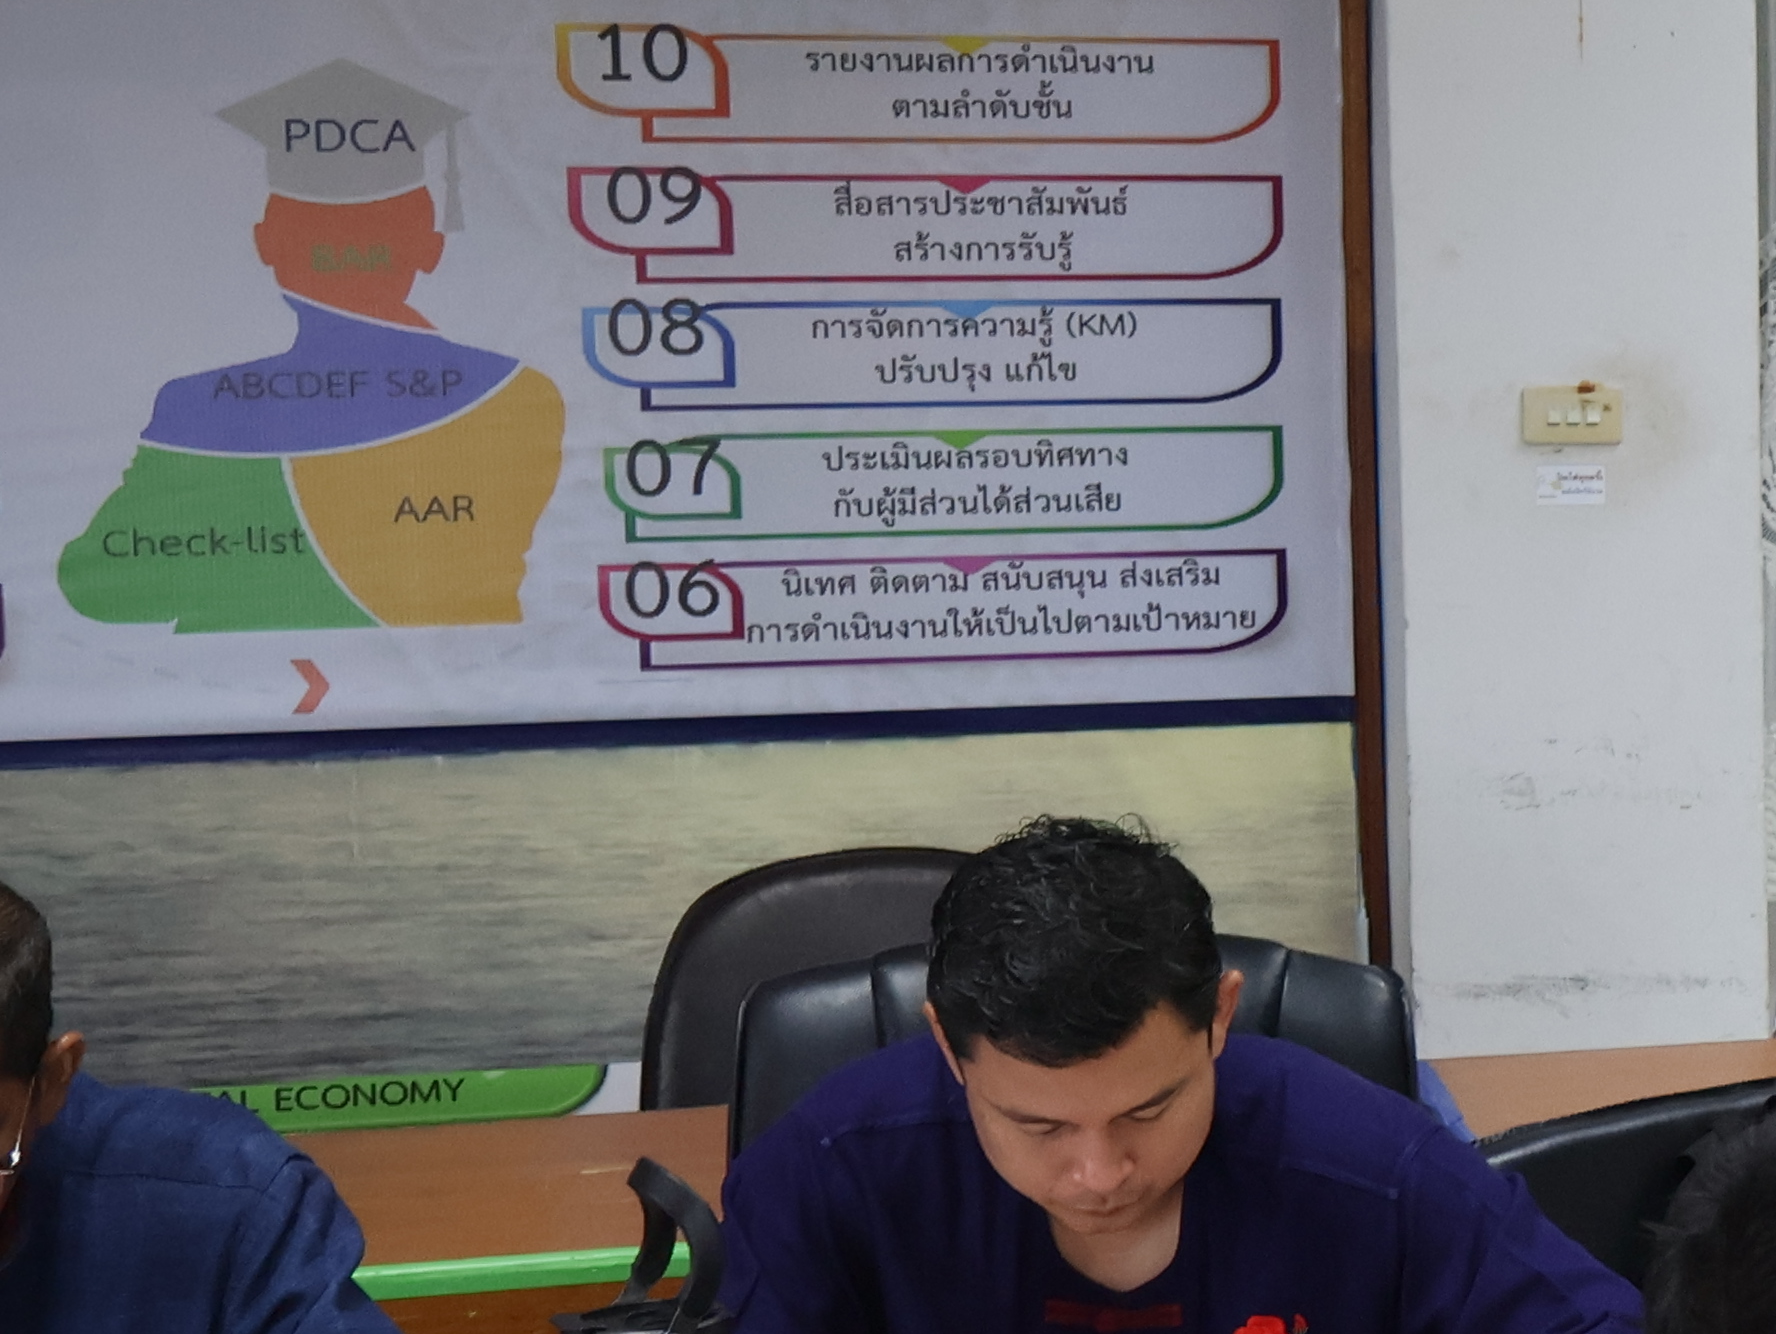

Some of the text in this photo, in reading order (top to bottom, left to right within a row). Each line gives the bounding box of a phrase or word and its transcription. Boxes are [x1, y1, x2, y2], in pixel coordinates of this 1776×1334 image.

[597, 22, 690, 83] 10
[805, 43, 1155, 77] รายงานผลการดำเนินงาน
[891, 81, 1074, 123] ตามลำดับชั้น
[284, 118, 417, 154] PDCA
[607, 165, 703, 225] 09
[833, 181, 1129, 219] สื่อสารประชาสัมพันธ์
[893, 228, 1075, 271] สร้างการรับรู้
[607, 298, 706, 358] 08
[810, 306, 1139, 346] การจัดการความรู้ (KM)
[212, 369, 464, 400] ABCDEF S&P
[874, 350, 1078, 394] ปรับปรุง แก้ไข
[625, 437, 721, 498] 07
[821, 442, 1130, 474] ประเมินผลรอบทิศทาง
[394, 495, 476, 524] AAR
[833, 483, 1122, 527] กับผู้มีส่วนได้ส่วนเสีย
[102, 524, 306, 560] Check-list
[623, 559, 723, 619] 06
[780, 558, 1222, 599] นิเทศ ติดตาม สนับสนุน ส่งเสริม
[745, 601, 1257, 646] การดำเนินงานให้เป็นไปตามเป้าหมาย
[273, 1077, 466, 1113] ECONOMY
